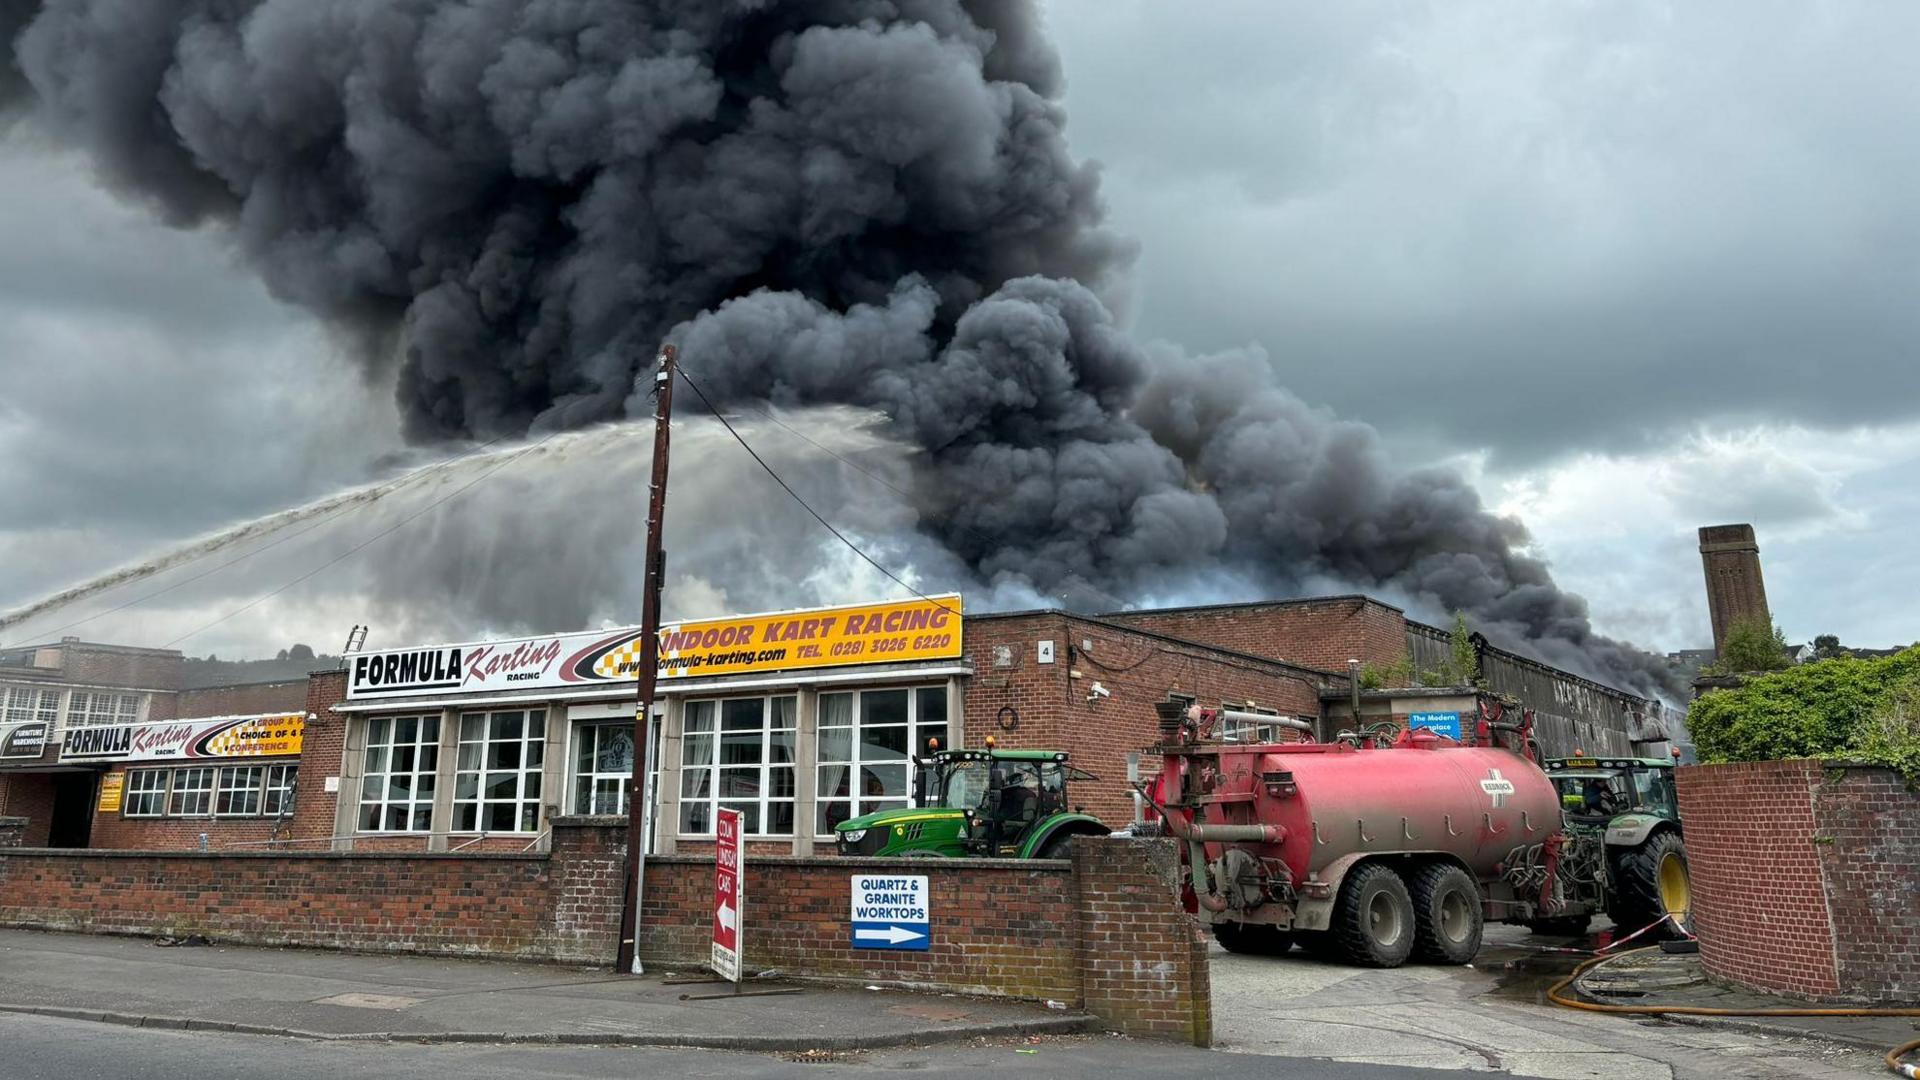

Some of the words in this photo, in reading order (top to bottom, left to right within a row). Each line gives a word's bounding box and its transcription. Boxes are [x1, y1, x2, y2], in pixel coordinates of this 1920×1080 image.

[661, 625, 755, 651] INDOOR
[763, 617, 836, 643] KART
[844, 607, 951, 635] RACING
[796, 645, 823, 659] TEL.
[830, 641, 865, 657] (028)
[870, 637, 907, 654] 3026
[912, 634, 951, 650] 6220
[1042, 647, 1049, 655] 4
[354, 649, 462, 686] FORMULA
[463, 640, 560, 686] Karting
[507, 672, 540, 682] RACING
[256, 718, 283, 727] GROUP
[62, 728, 131, 754] FORMULA
[130, 724, 192, 754] Karting
[240, 730, 271, 740] CHOICE
[277, 729, 287, 738] OF
[291, 729, 297, 737] 4
[229, 742, 288, 752] CONFERENCE
[861, 879, 907, 890] QUARTZ
[910, 879, 919, 890] &
[864, 893, 915, 904] GRANITE
[856, 907, 924, 919] WORKTOPS
